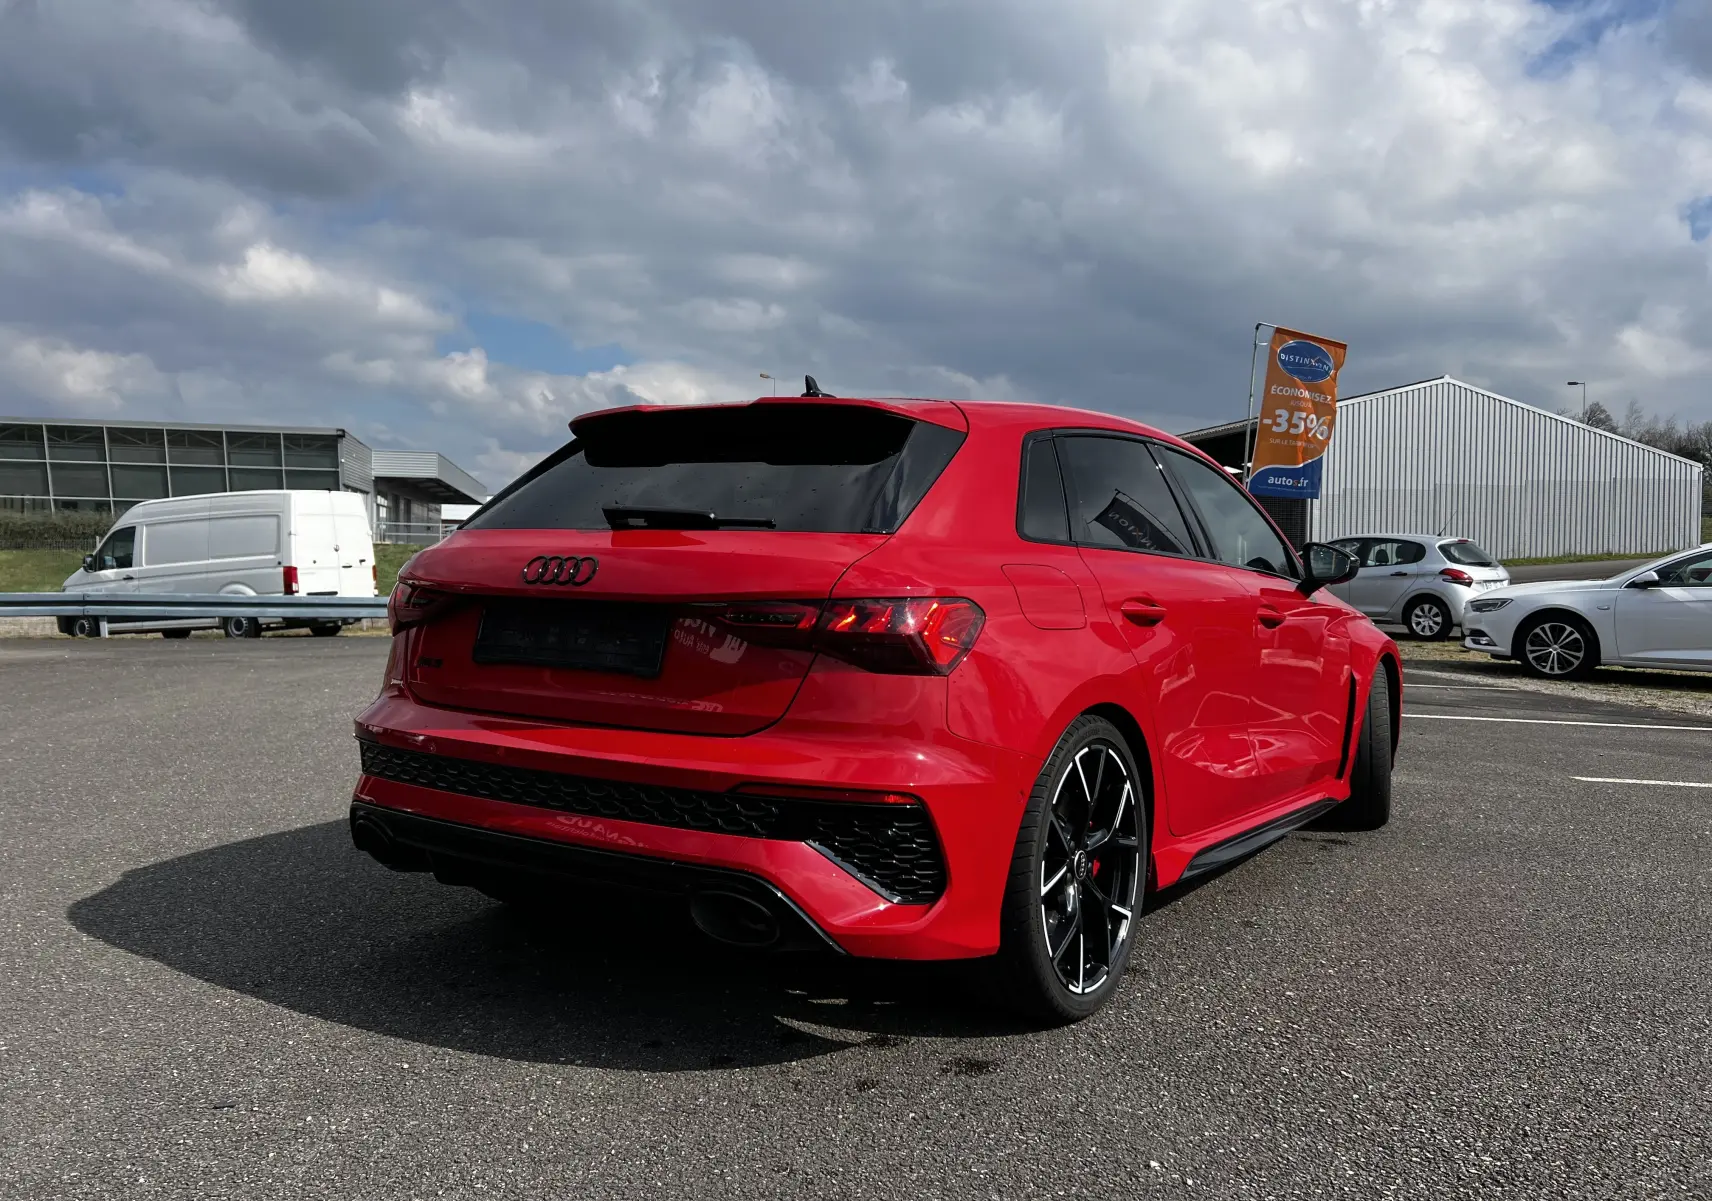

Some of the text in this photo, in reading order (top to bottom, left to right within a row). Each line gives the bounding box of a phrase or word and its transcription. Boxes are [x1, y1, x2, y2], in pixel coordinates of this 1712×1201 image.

[1270, 384, 1332, 404] ÉCONOMISEZ
[1262, 408, 1332, 439] -35%
[1268, 476, 1309, 487] autos.fr
